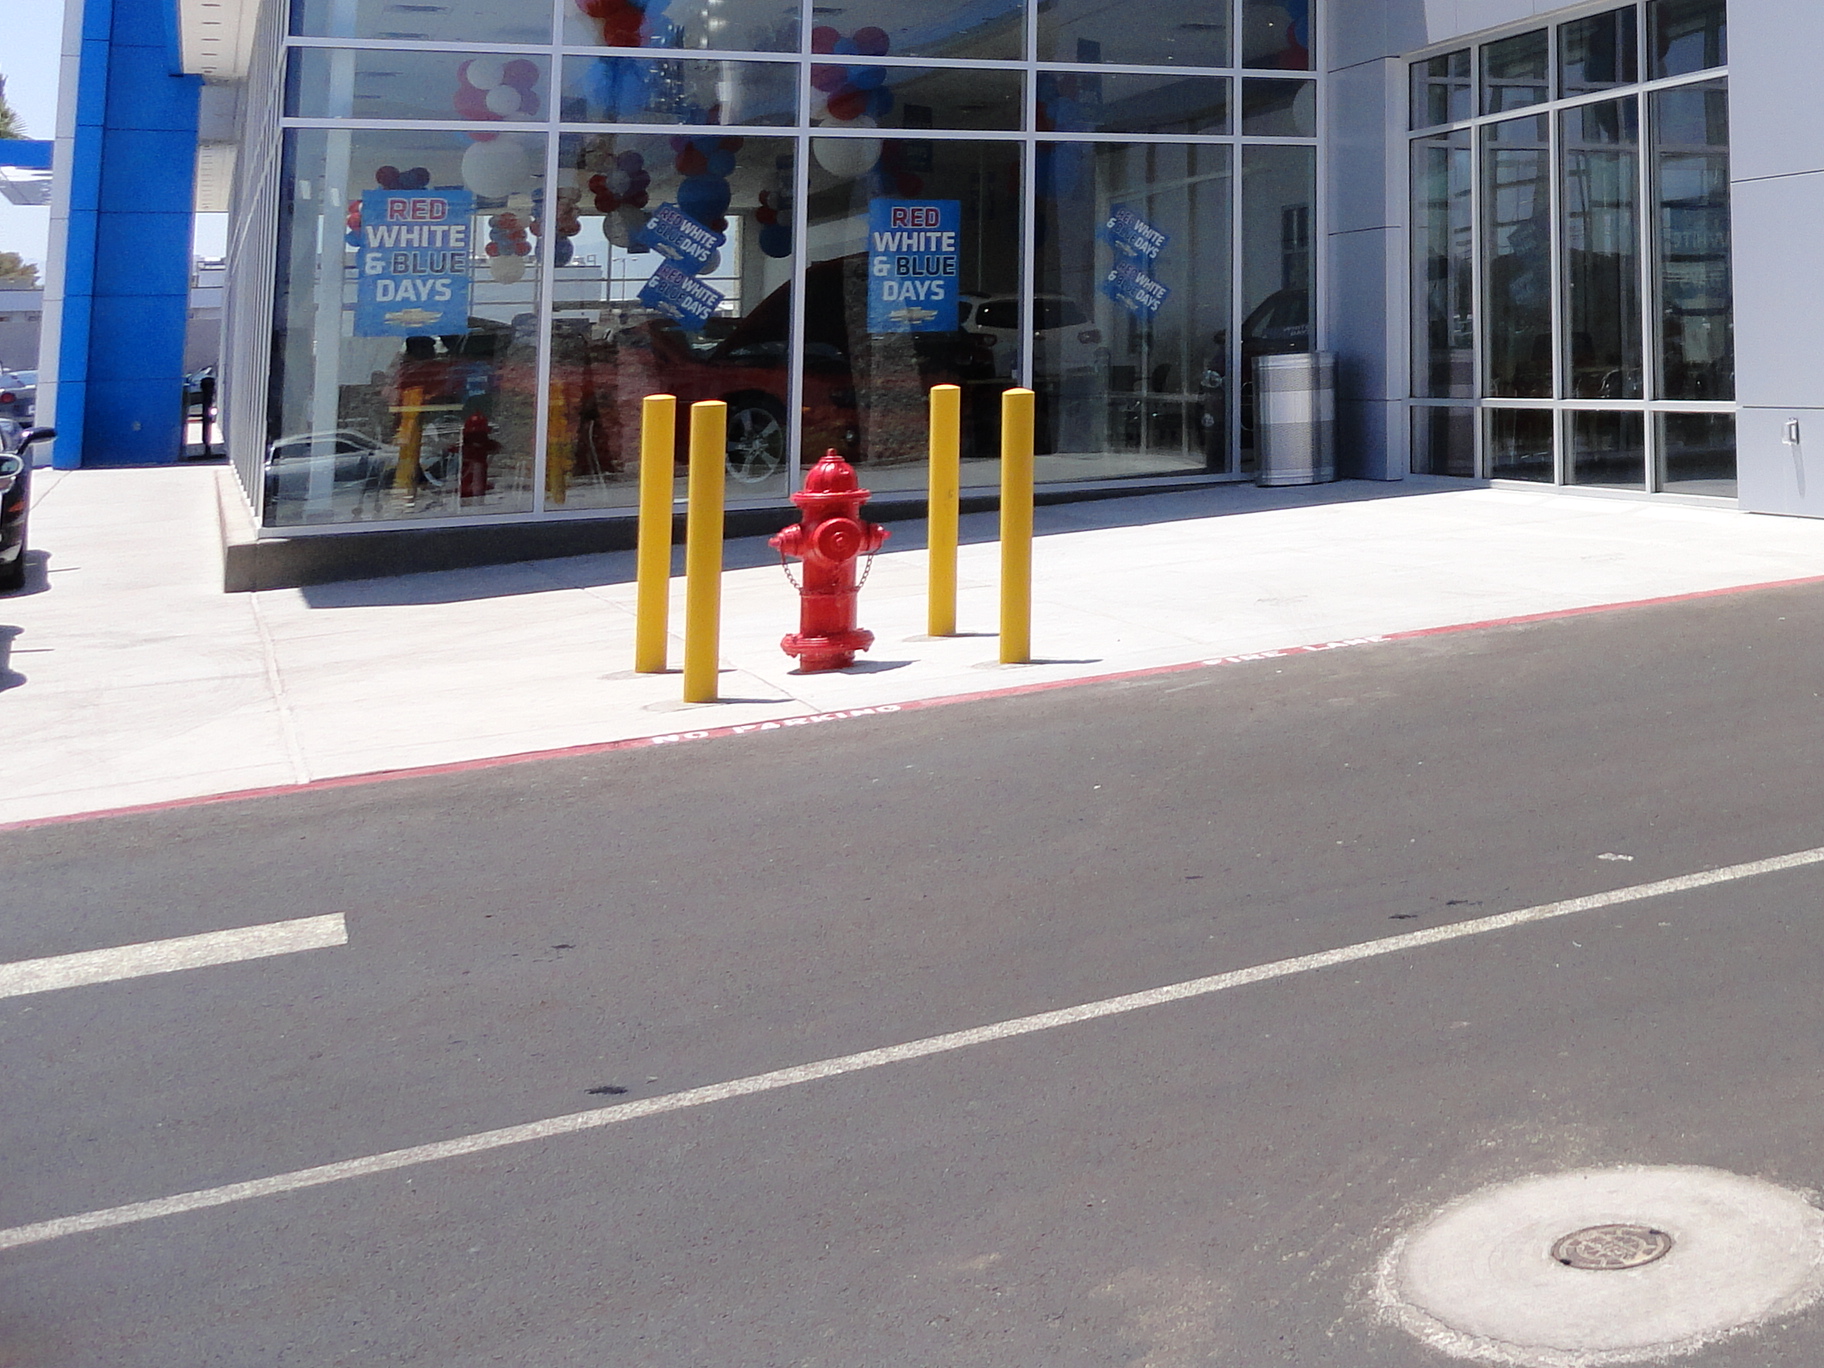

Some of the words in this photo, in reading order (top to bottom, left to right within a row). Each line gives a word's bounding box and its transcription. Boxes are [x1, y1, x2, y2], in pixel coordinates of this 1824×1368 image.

[387, 197, 448, 222] RED
[891, 207, 940, 228] RED
[365, 225, 466, 248] WHITE
[647, 218, 658, 230] &
[656, 222, 682, 245] BLUE
[680, 239, 711, 262] DAYS
[659, 207, 682, 228] RED
[681, 219, 717, 248] WHITE
[1107, 217, 1117, 229] &
[1134, 237, 1159, 259] DAYS
[1134, 219, 1165, 246] WHITE
[873, 232, 956, 252] WHITE
[364, 253, 386, 275] &
[392, 252, 466, 276] BLUE
[873, 256, 890, 277] &
[896, 255, 956, 277] BLUE
[376, 279, 452, 303] DAYS
[648, 276, 659, 288] &
[658, 280, 684, 304] BLUE
[681, 296, 712, 320] DAYS
[659, 265, 683, 285] RED
[682, 277, 718, 306] WHITE
[882, 280, 944, 301] DAYS
[1108, 270, 1118, 281] &
[1135, 290, 1161, 311] DAYS
[1135, 272, 1166, 298] WHITE
[652, 731, 710, 744] NO
[732, 704, 902, 734] PARKING
